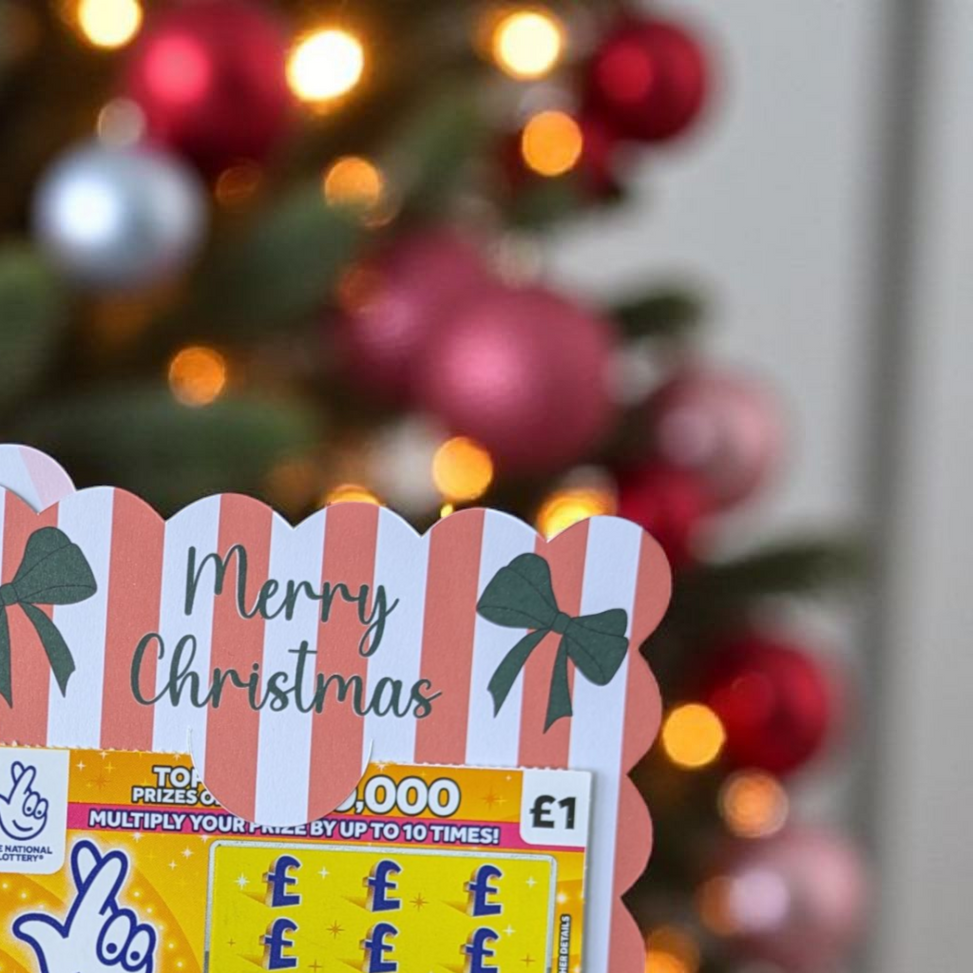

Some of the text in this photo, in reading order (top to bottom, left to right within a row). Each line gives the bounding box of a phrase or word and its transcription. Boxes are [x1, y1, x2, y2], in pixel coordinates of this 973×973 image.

[184, 544, 399, 658] Merry
[130, 632, 443, 719] Christmas
[132, 787, 197, 806] PRIZES
[529, 794, 577, 830] £1
[89, 810, 186, 831] MULTIPLY
[189, 814, 245, 833] YOUR
[310, 820, 337, 837] BY
[339, 821, 368, 839] UP
[371, 823, 400, 840] TO
[403, 824, 427, 842] 10
[430, 825, 500, 845] TIMES!
[4, 844, 53, 855] NATIONAL
[263, 855, 503, 917] £ £ £
[259, 917, 298, 970] £
[559, 915, 571, 954] DETAILS
